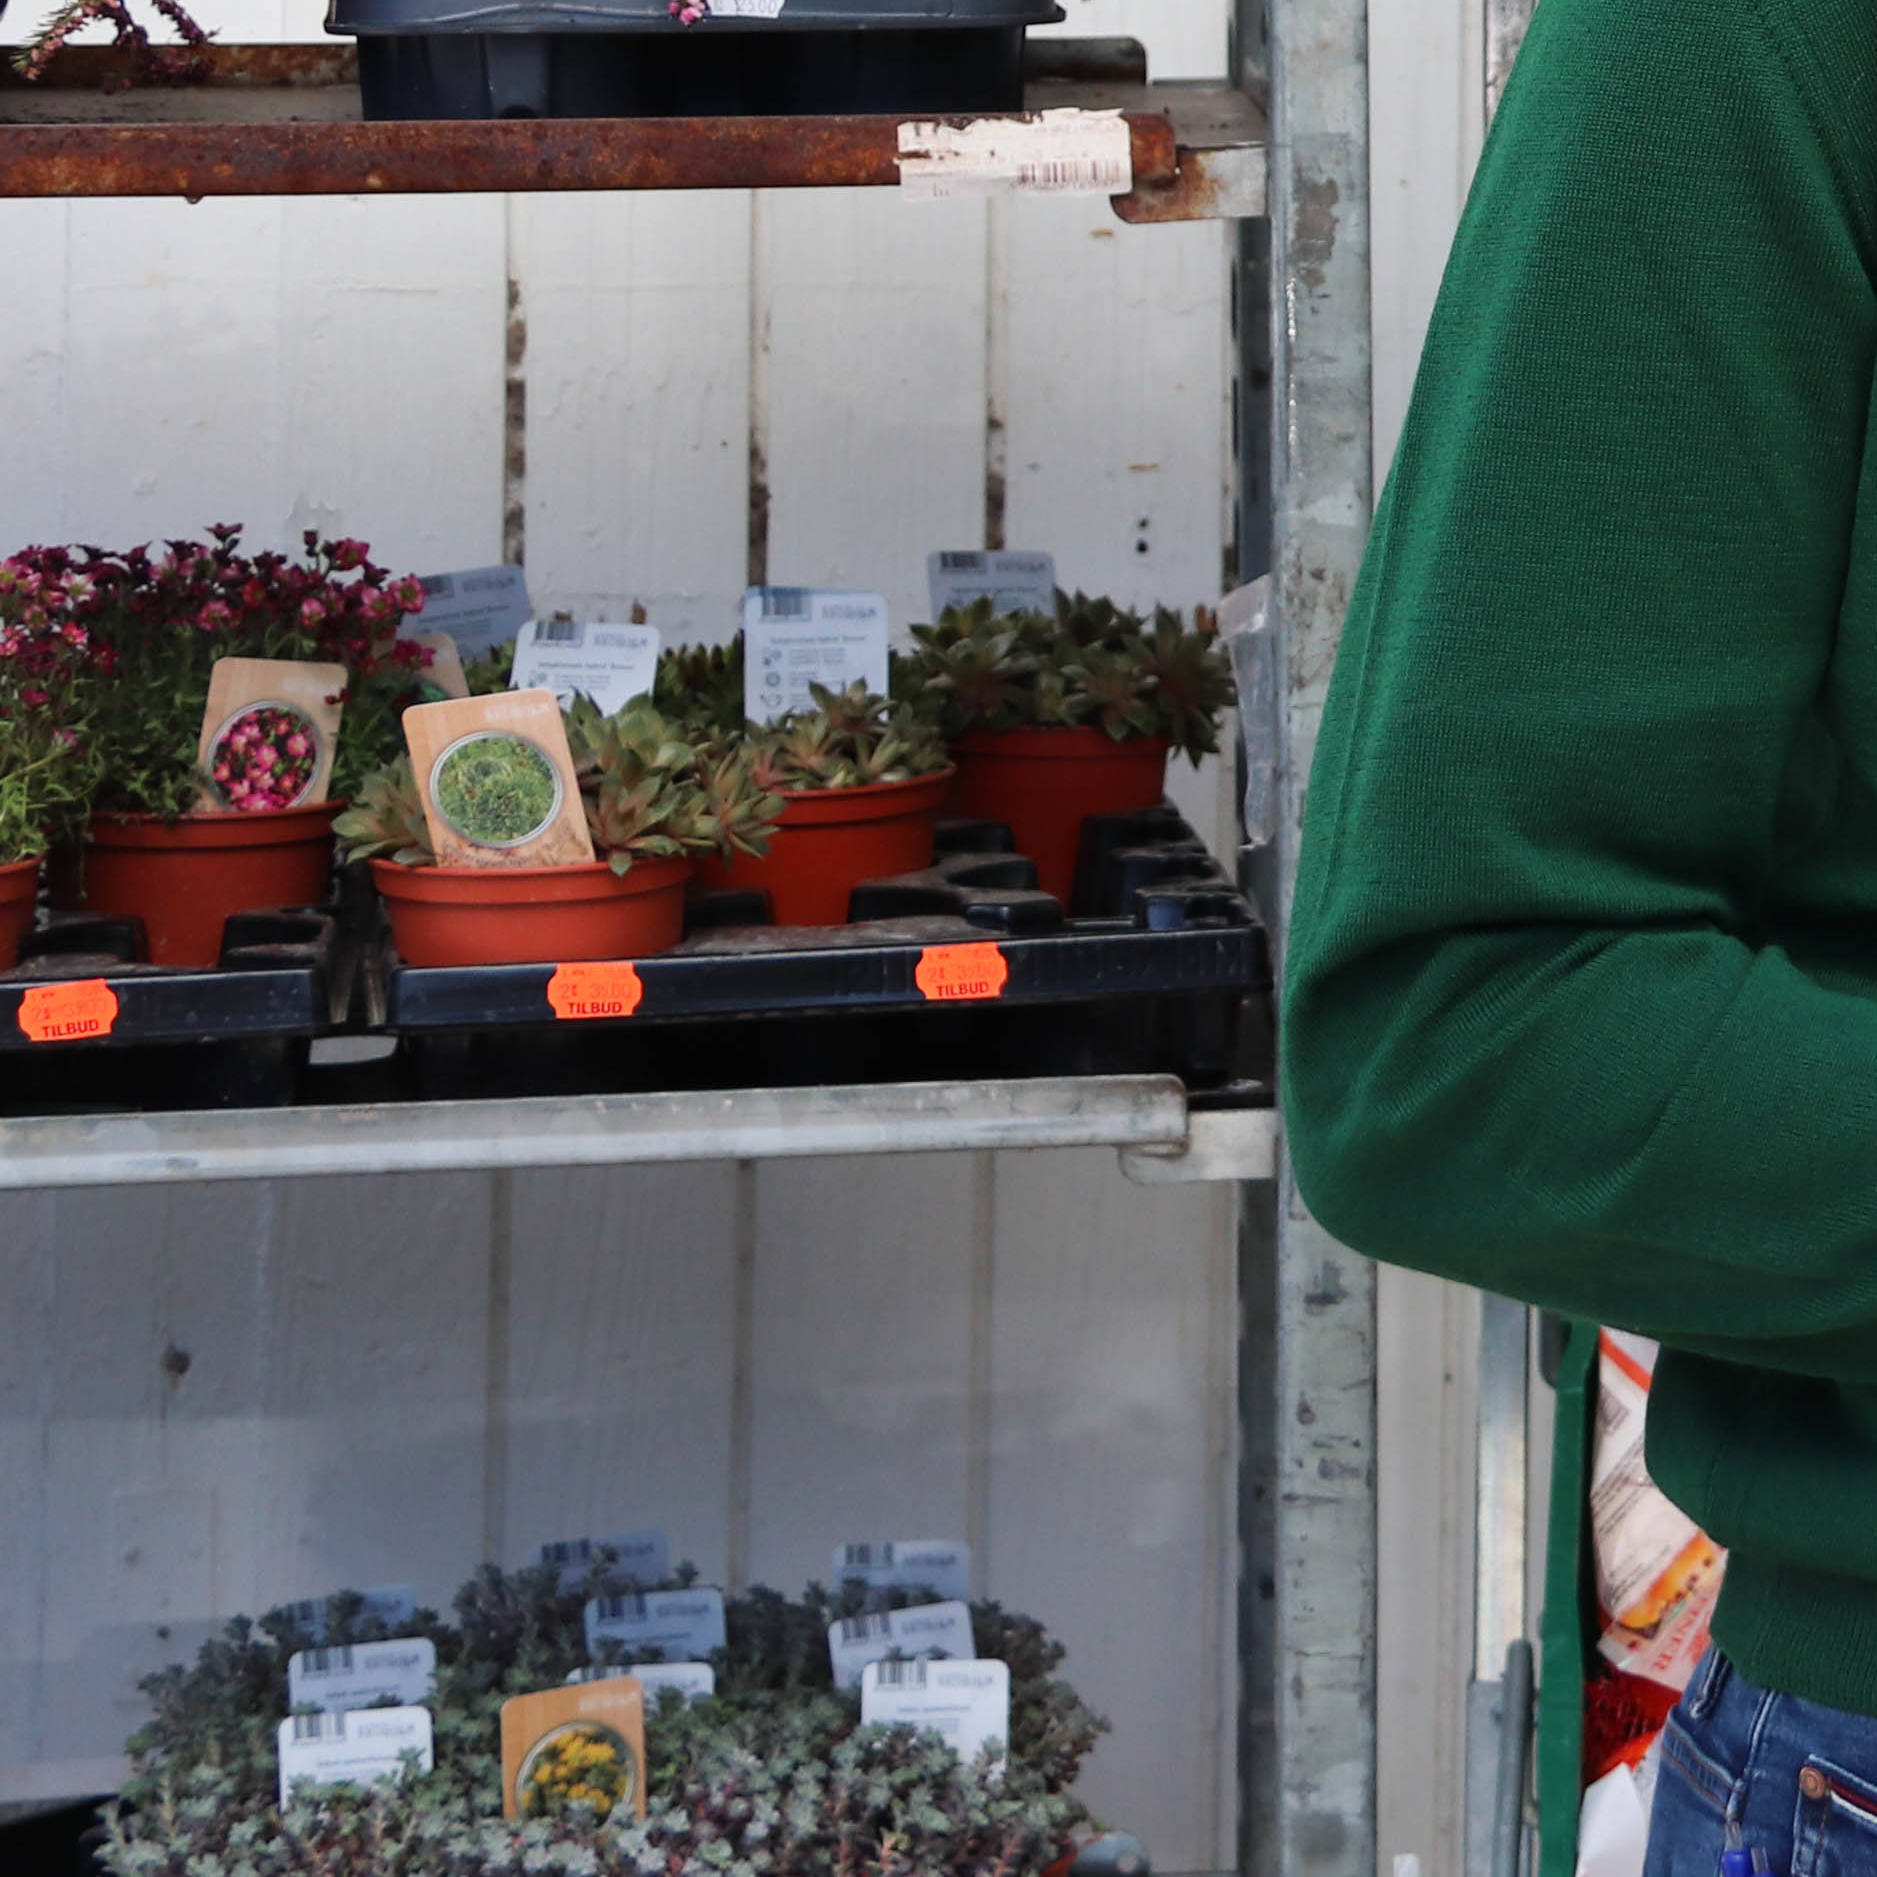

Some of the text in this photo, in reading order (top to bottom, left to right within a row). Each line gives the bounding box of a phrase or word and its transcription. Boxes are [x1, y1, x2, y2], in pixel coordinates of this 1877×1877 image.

[936, 980, 990, 997] TILBUD
[567, 1001, 623, 1015] TILBUD
[41, 1018, 99, 1038] TILBUD
